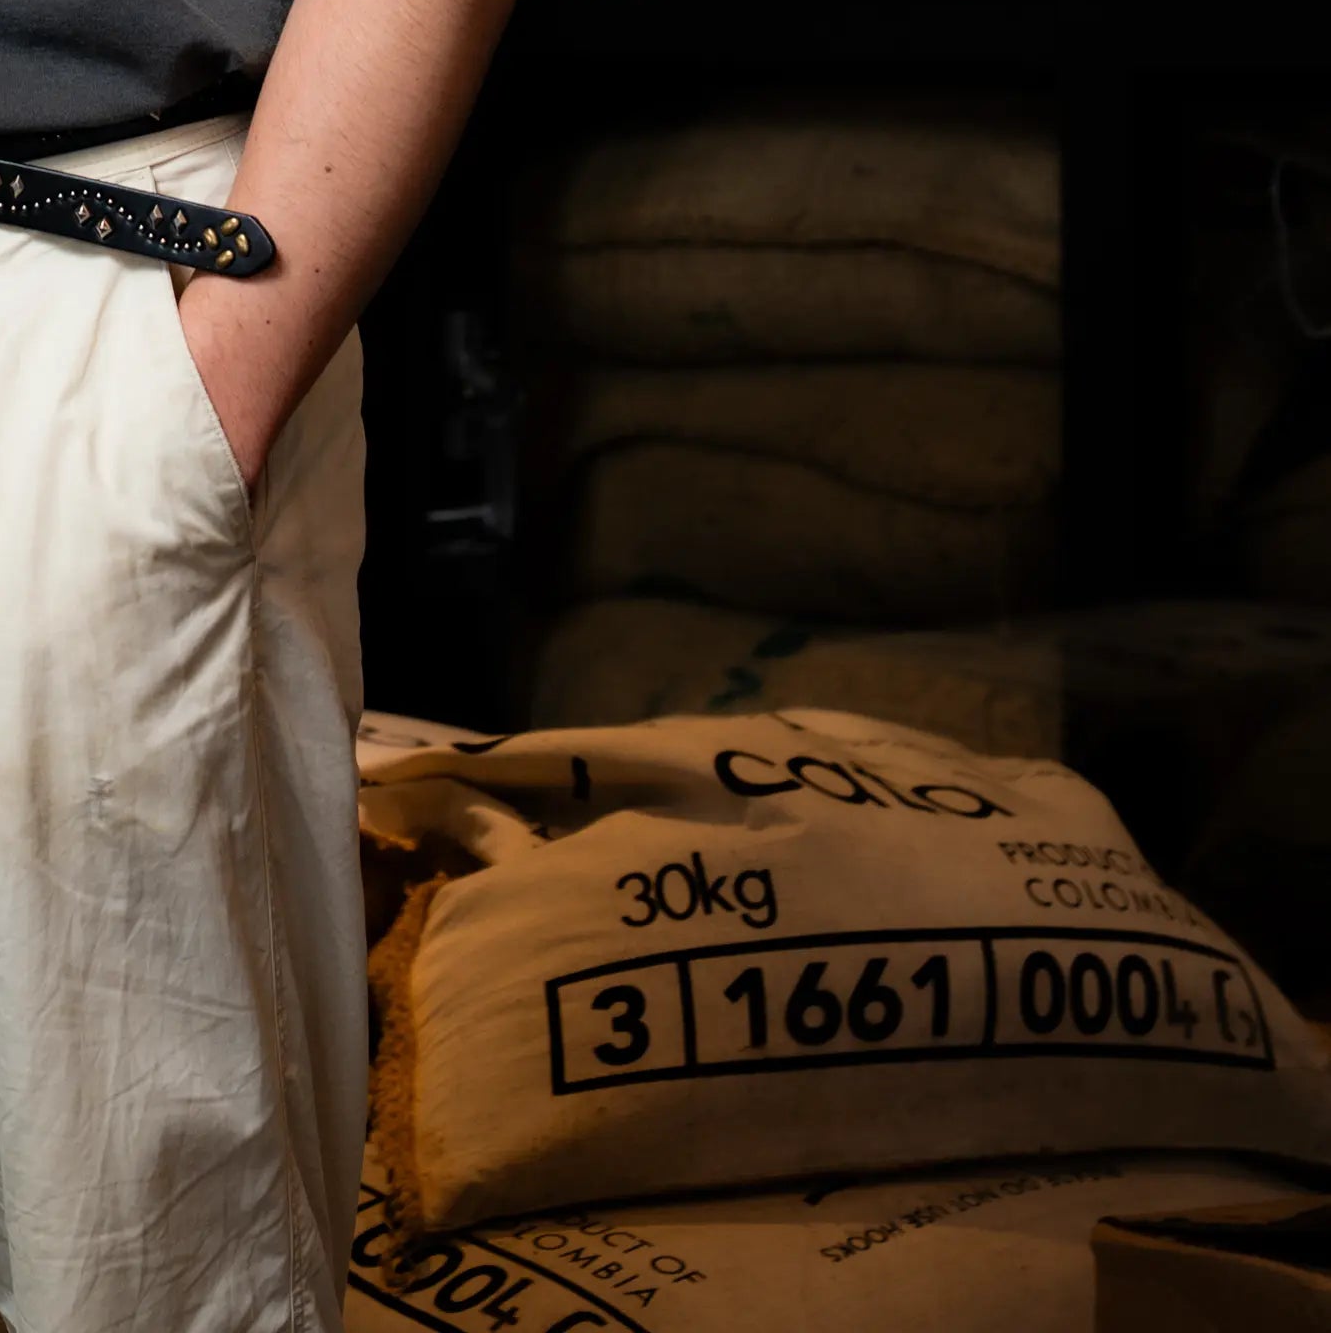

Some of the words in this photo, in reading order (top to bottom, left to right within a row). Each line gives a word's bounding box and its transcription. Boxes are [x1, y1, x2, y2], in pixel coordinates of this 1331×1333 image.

[997, 841, 1142, 877] PRODUC
[615, 851, 778, 929] 30kg
[591, 984, 650, 1066] 3
[723, 955, 951, 1049] 1661
[819, 1220, 902, 1263] HOOKS
[651, 1255, 707, 1283] OF
